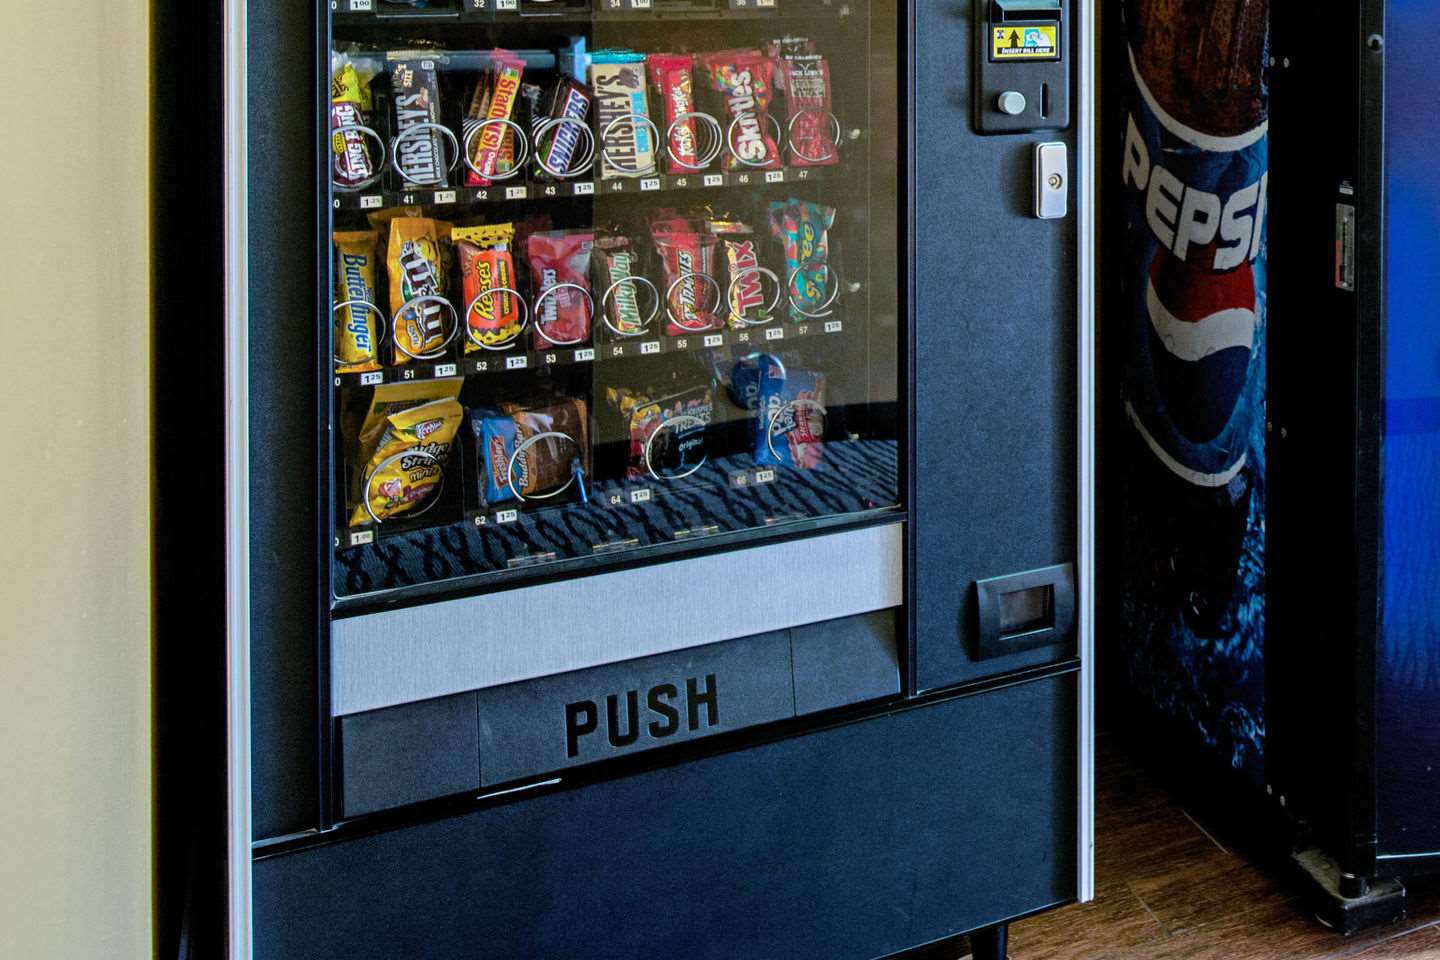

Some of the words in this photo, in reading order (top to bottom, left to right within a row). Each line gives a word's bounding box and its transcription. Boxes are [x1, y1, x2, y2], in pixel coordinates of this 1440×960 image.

[474, 0, 485, 8] 32
[610, 0, 621, 8] 34
[404, 70, 413, 87] SIZE
[549, 89, 588, 173] SNICKERS
[798, 170, 808, 179] 47
[677, 178, 687, 187] 45
[739, 175, 749, 184] 46
[545, 186, 556, 196] 43
[612, 182, 623, 191] 44
[476, 190, 488, 200] 42
[1122, 112, 1268, 271] PEPSI
[403, 194, 414, 204] 41
[734, 240, 764, 316] TWIX
[474, 261, 496, 320] Reese's
[799, 326, 808, 335] 57
[739, 333, 749, 342] 56
[677, 340, 687, 349] 55
[612, 347, 623, 356] 54
[546, 354, 556, 364] 53
[476, 361, 488, 371] 52
[404, 370, 415, 379] 51
[611, 495, 621, 504] 64
[475, 516, 486, 525] 62
[565, 673, 719, 758] PUSH
